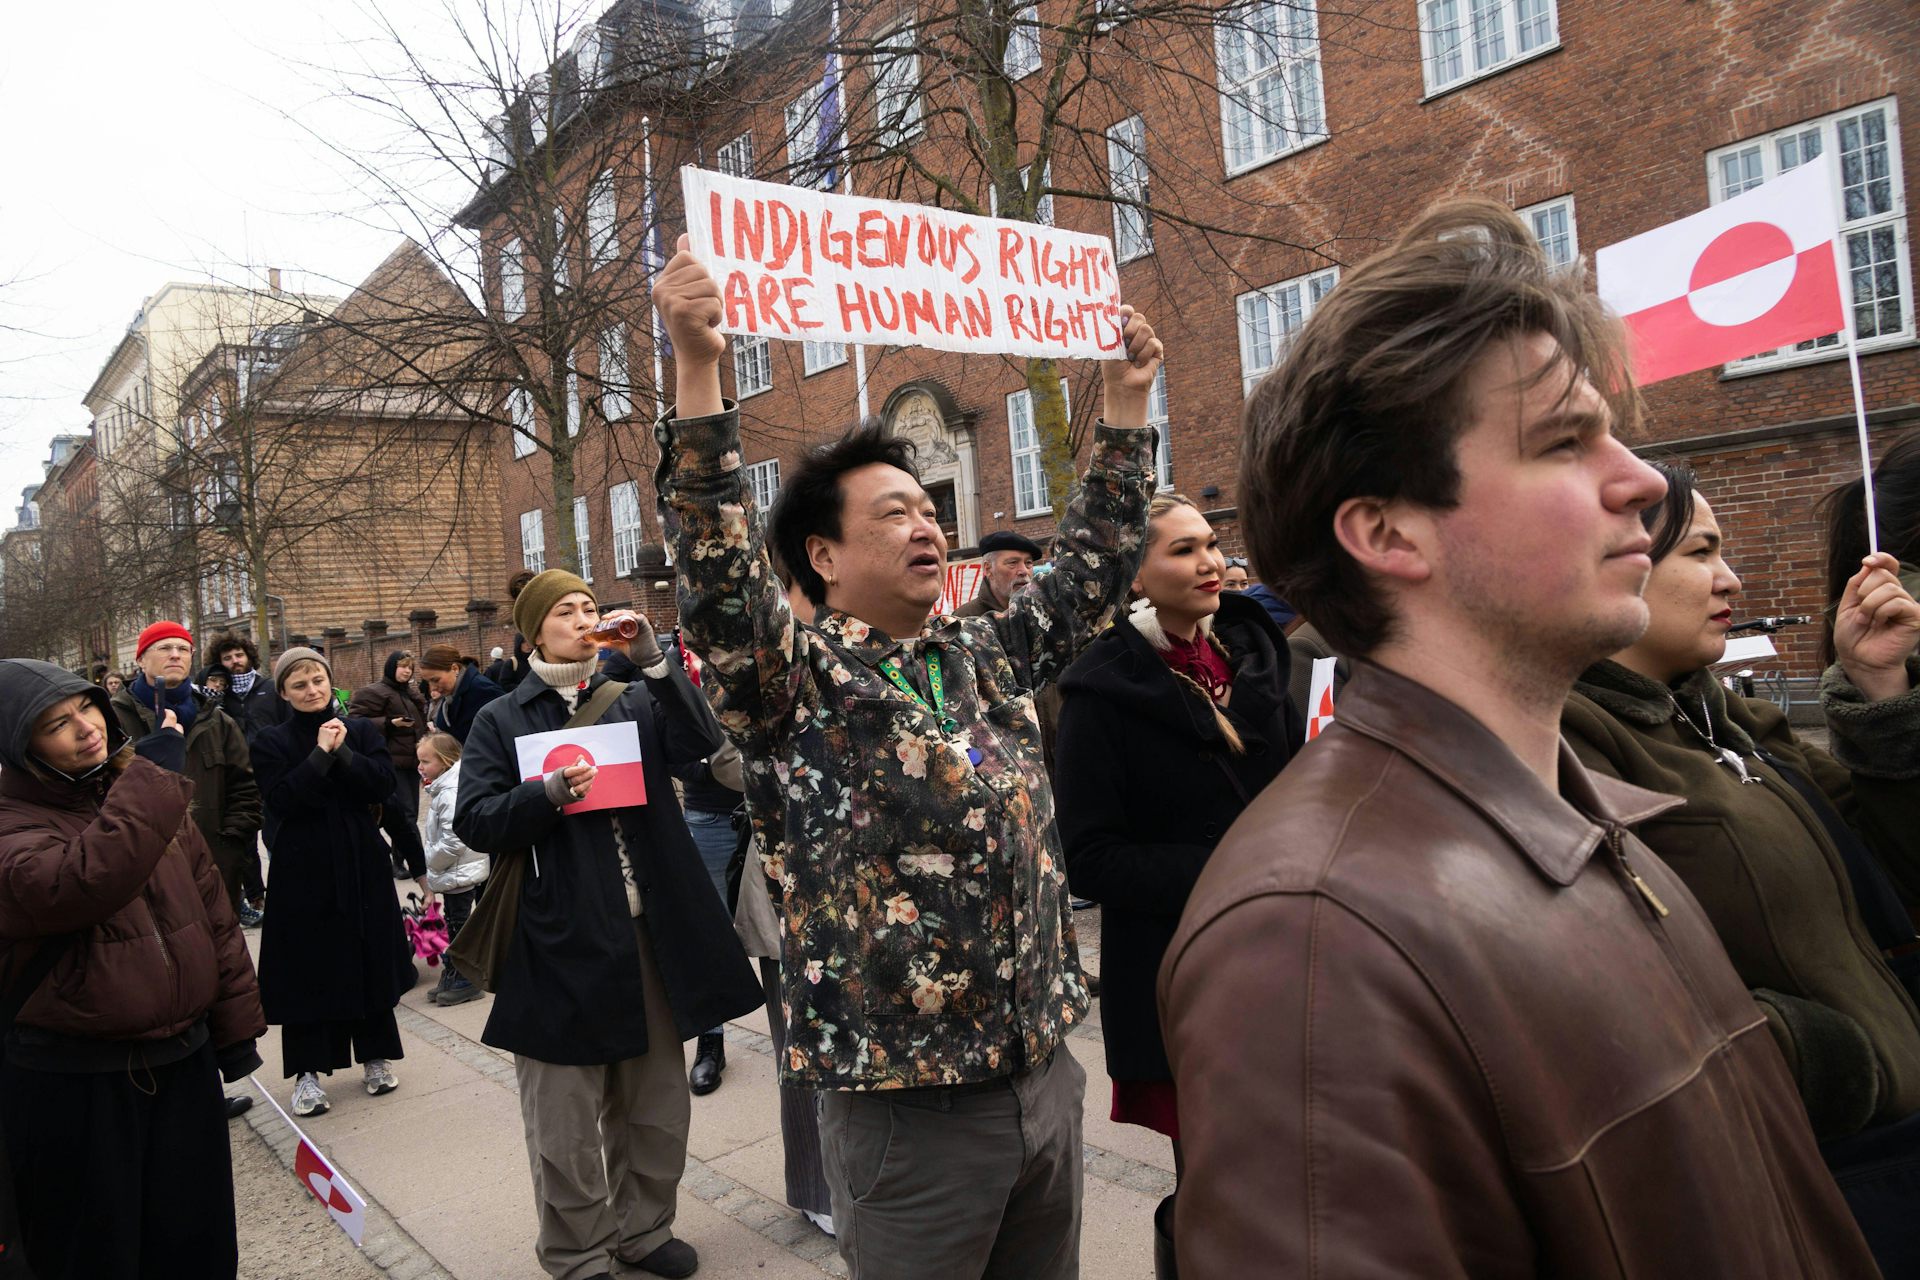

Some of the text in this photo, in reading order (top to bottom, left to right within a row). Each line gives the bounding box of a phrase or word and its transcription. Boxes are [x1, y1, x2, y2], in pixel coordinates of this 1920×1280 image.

[710, 191, 981, 284] INDIGENOUS
[725, 271, 1122, 351] ARE HUMAN RIGHTS
